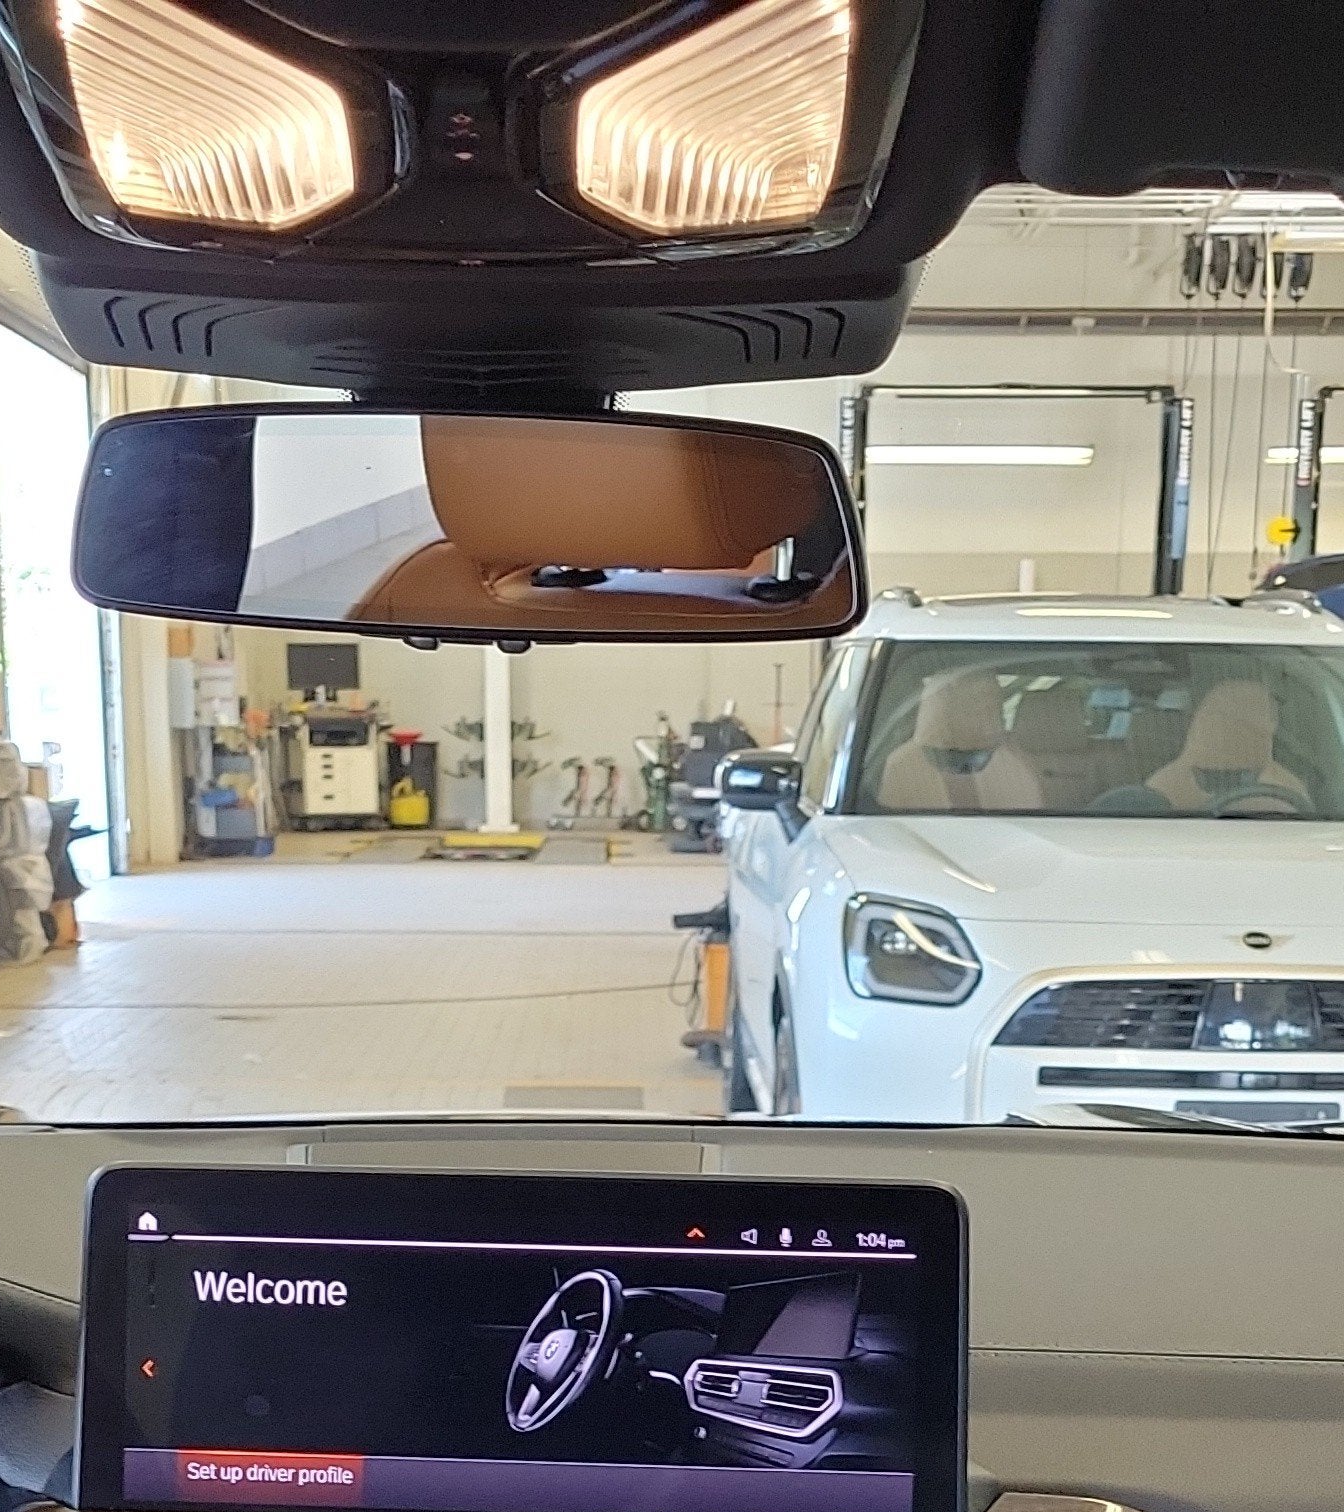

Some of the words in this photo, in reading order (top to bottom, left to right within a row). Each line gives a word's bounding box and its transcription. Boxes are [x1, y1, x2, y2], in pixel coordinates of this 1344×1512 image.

[193, 1270, 348, 1306] Welcome
[187, 1462, 218, 1480] Set
[220, 1466, 243, 1483] up
[246, 1463, 296, 1482] driver
[298, 1466, 354, 1486] profile
